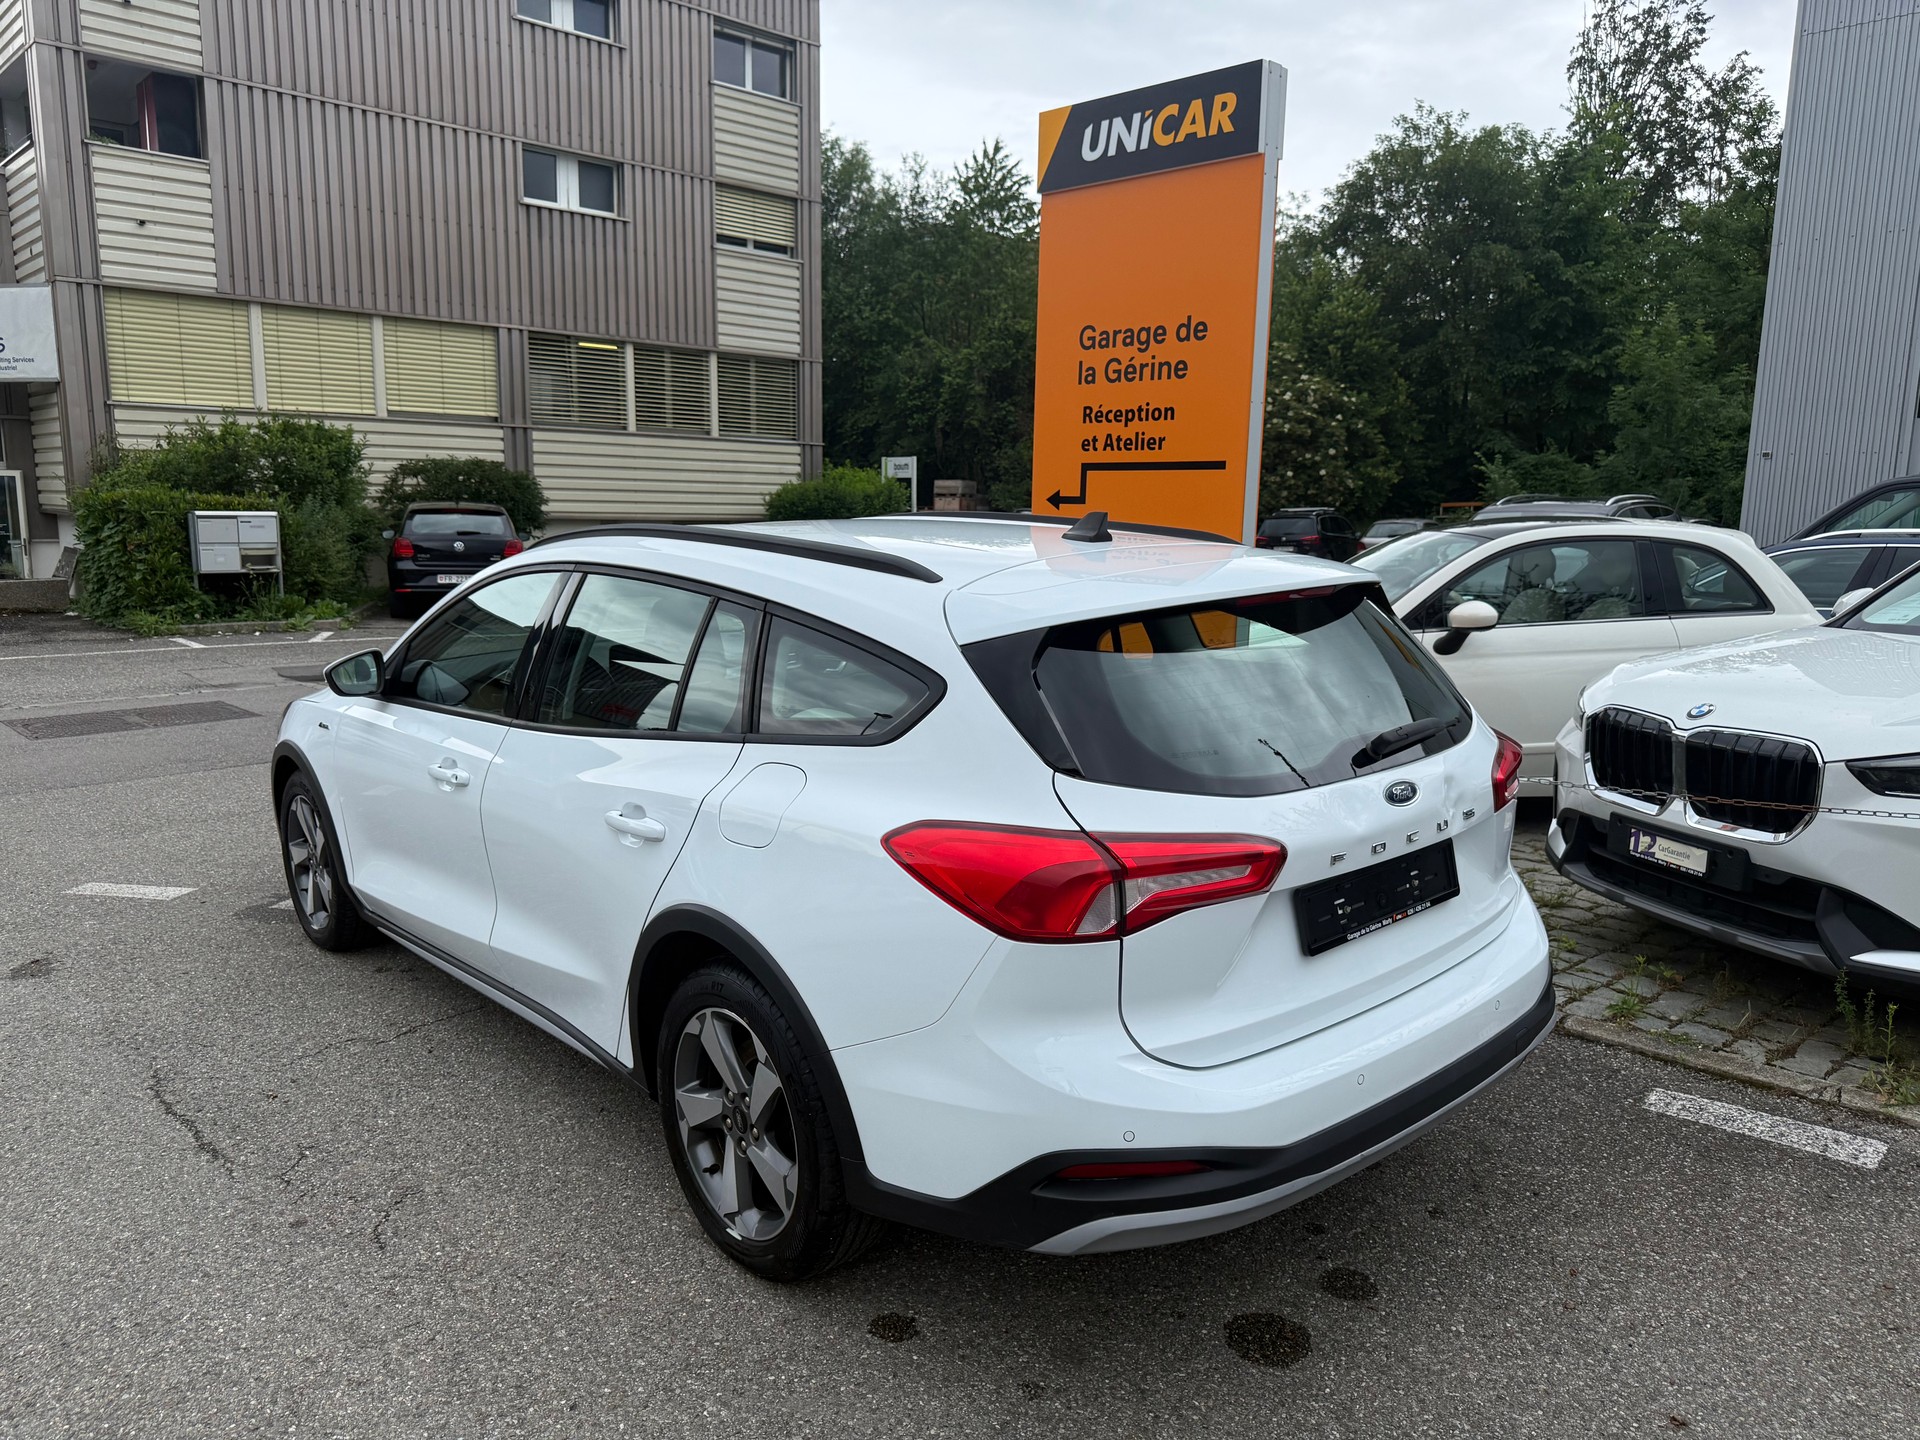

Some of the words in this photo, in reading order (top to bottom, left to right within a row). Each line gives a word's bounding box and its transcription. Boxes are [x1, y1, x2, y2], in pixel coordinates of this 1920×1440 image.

[1079, 325, 1167, 353] Garage
[1175, 315, 1208, 343] de
[1078, 360, 1096, 385] la
[1104, 355, 1188, 383] Gérine
[1082, 402, 1175, 427] Réception
[1081, 435, 1098, 452] et
[1103, 432, 1166, 452] Atelier
[1393, 785, 1413, 800] Ford
[1330, 808, 1475, 866] FOCUS
[1658, 843, 1691, 861] CarGarantie
[1347, 931, 1361, 940] Garage
